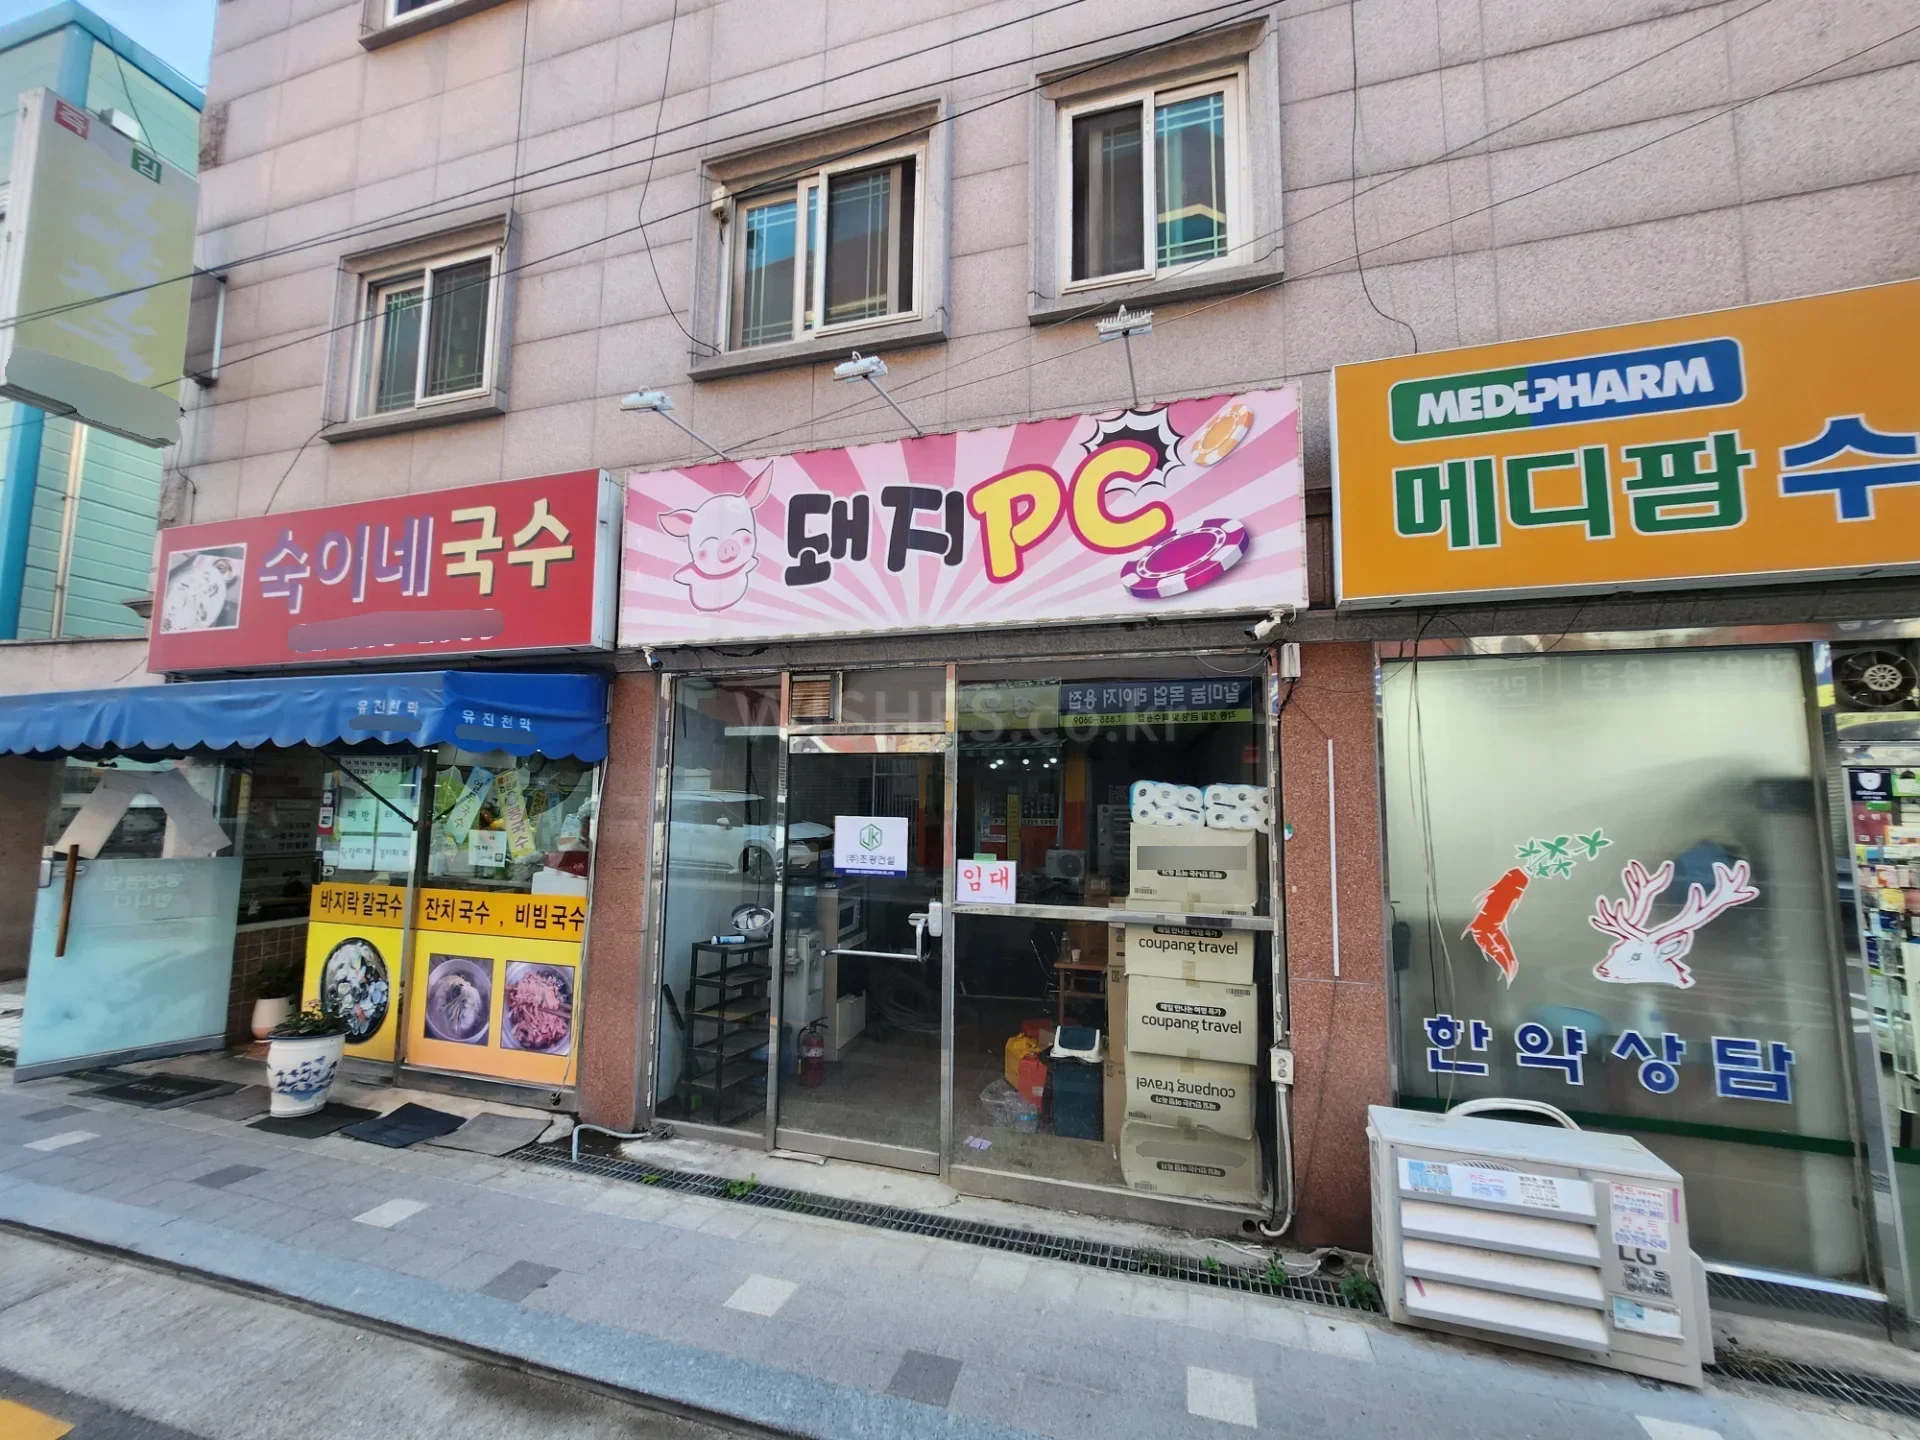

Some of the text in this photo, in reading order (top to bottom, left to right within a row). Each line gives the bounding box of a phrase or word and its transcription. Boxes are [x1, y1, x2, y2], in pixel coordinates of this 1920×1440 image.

[137, 153, 159, 180] 김
[1391, 429, 1757, 551] 메디팜
[356, 700, 420, 716] 유진천막
[461, 709, 532, 732] 유진천막
[963, 865, 1009, 894] 임대
[320, 889, 403, 916] 바지락칼국수
[425, 897, 491, 925] 잔치국수
[515, 903, 586, 932] 비빔국수
[1138, 938, 1238, 955] coupang travel
[1142, 1015, 1242, 1034] coupang travel
[1423, 1013, 1796, 1105] 한약상담
[1136, 1076, 1236, 1098] coupang travel
[1618, 1244, 1657, 1266] LG
